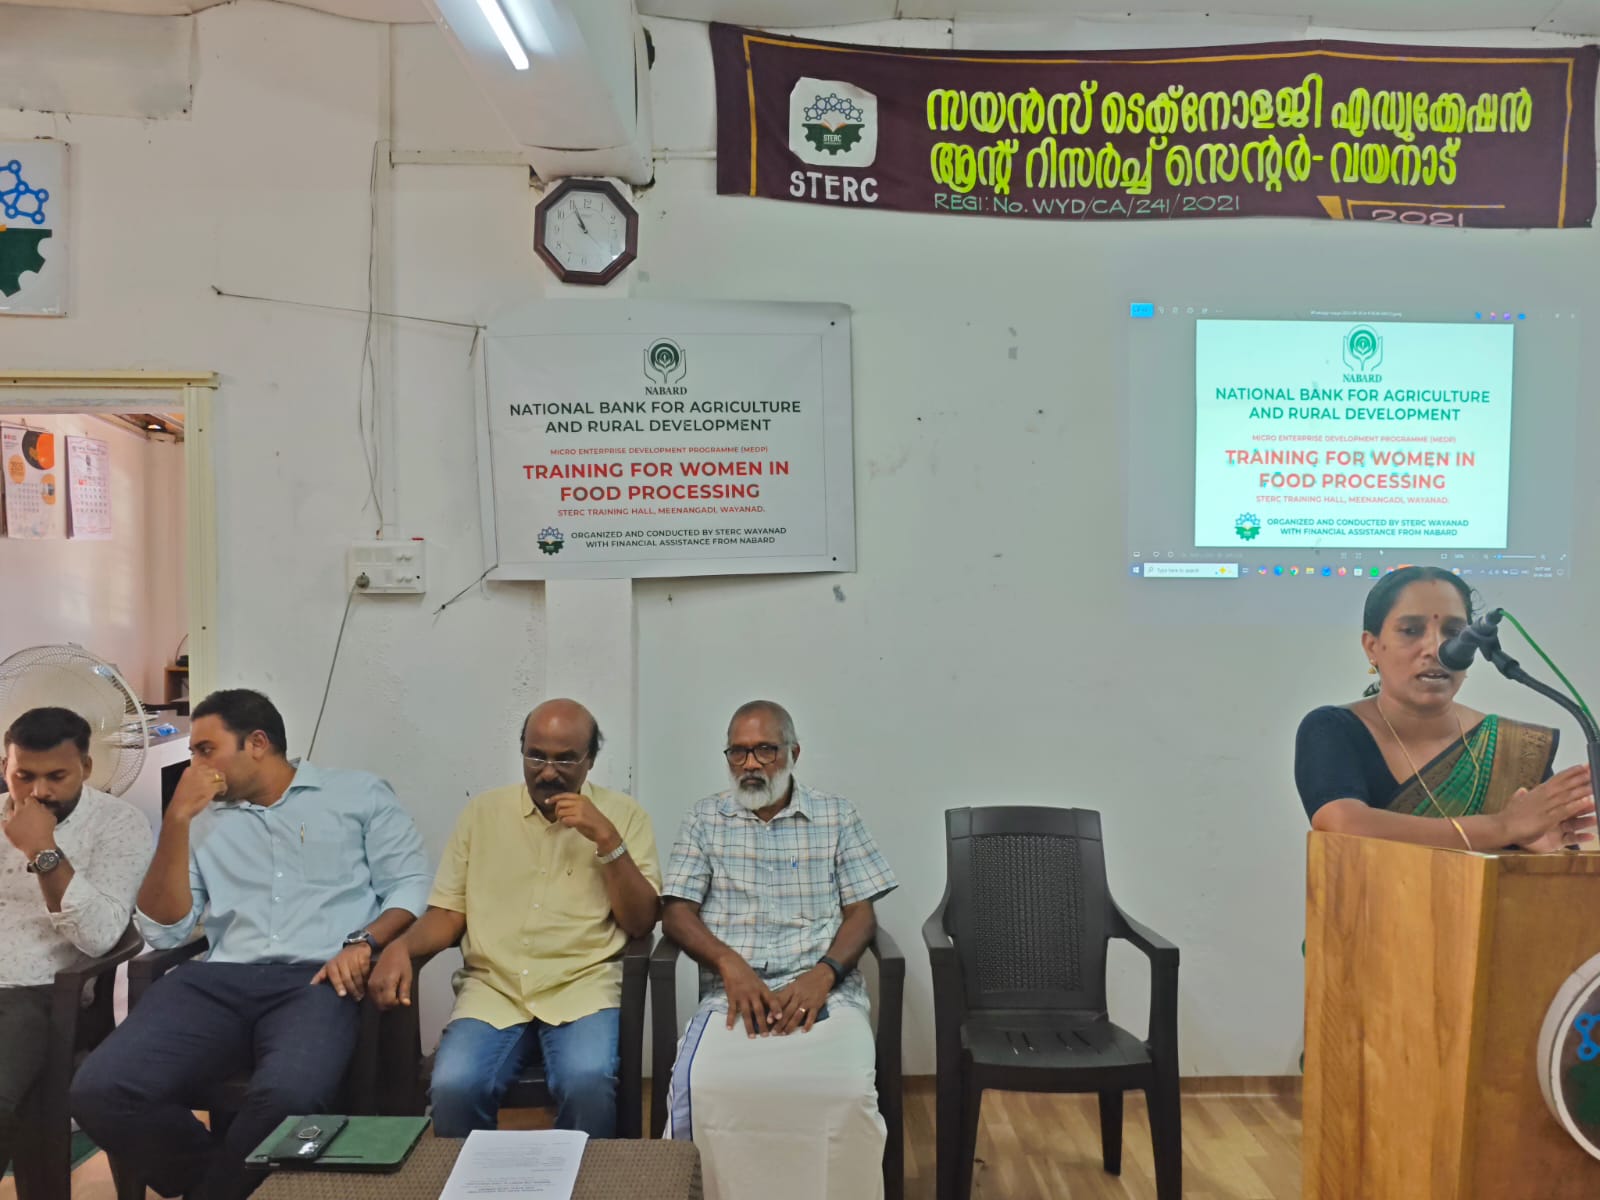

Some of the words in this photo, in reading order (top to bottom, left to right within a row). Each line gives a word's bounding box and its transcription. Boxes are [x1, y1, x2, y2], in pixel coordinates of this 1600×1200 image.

[927, 80, 1098, 135] സയൻസ്
[823, 134, 842, 142] STERC
[1330, 137, 1461, 186] വയനാട്
[789, 170, 879, 203] STERC
[993, 196, 1028, 213] No.
[1032, 194, 1240, 220] WYD/CA/241/2021
[1371, 209, 1464, 227] 2021
[1342, 374, 1382, 383] NABARD
[645, 386, 687, 395] NABARD
[1215, 387, 1295, 401] NATIONAL
[1300, 388, 1343, 402] BANK
[1348, 388, 1380, 402] FOR
[1383, 389, 1490, 403] AGRICULTURE
[510, 403, 594, 416] NATIONAL
[600, 402, 646, 414] BANK
[652, 402, 685, 414] FOR
[690, 401, 801, 413] AGRICULTURE
[1249, 406, 1284, 421] AND
[1288, 407, 1341, 421] RURAL
[1345, 407, 1460, 421] DEVELOPMENT
[545, 421, 582, 433] AND
[588, 420, 644, 432] RURAL
[649, 419, 771, 432] DEVELOPMENT
[1252, 434, 1278, 442] MICRO
[1279, 434, 1323, 442] ENTERPRISE
[1324, 435, 1379, 443] DEVELOPMENT
[1380, 435, 1429, 443] PROGRAMME
[1430, 435, 1456, 444] (MEDP)
[550, 448, 577, 456] MICRO
[1226, 449, 1320, 467] TRAINING
[1326, 450, 1365, 467] FOR
[1371, 450, 1450, 467] WOMEN
[1455, 452, 1475, 467] IN
[523, 463, 624, 480] TRAINING
[631, 462, 673, 477] FOR
[680, 461, 763, 477] WOMEN
[769, 461, 789, 475] IN
[1259, 473, 1316, 489] FOOD
[1322, 473, 1446, 490] PROCESSING
[560, 486, 621, 502] FOOD
[628, 484, 760, 500] PROCESSING
[1283, 496, 1321, 504] TRAINING
[1323, 496, 1347, 505] HALL,
[558, 509, 585, 517] STERC
[587, 508, 628, 516] TRAINING
[631, 508, 656, 516] HALL,
[1267, 518, 1315, 527] ORGANIZED
[1317, 518, 1334, 527] AND
[1337, 519, 1388, 527] CONDUCTED
[1389, 519, 1400, 527] BY
[1401, 519, 1427, 527] STERC
[1428, 519, 1469, 527] WAYANAD
[571, 530, 623, 539] ORGANIZED
[625, 530, 644, 538] AND
[646, 529, 701, 537] CONDUCTED
[715, 528, 742, 536] STERC
[743, 527, 786, 535] WAYANAD
[1280, 528, 1301, 536] WITH
[1303, 528, 1346, 536] FINANCIAL
[1348, 528, 1396, 536] ASSISTANCE
[1398, 528, 1422, 536] FROM
[1424, 528, 1458, 536] NABARD
[586, 540, 609, 548] WITH
[611, 539, 657, 547] FINANCIAL
[659, 538, 710, 546] ASSISTANCE
[712, 537, 738, 545] FROM
[740, 536, 775, 545] NABARD
